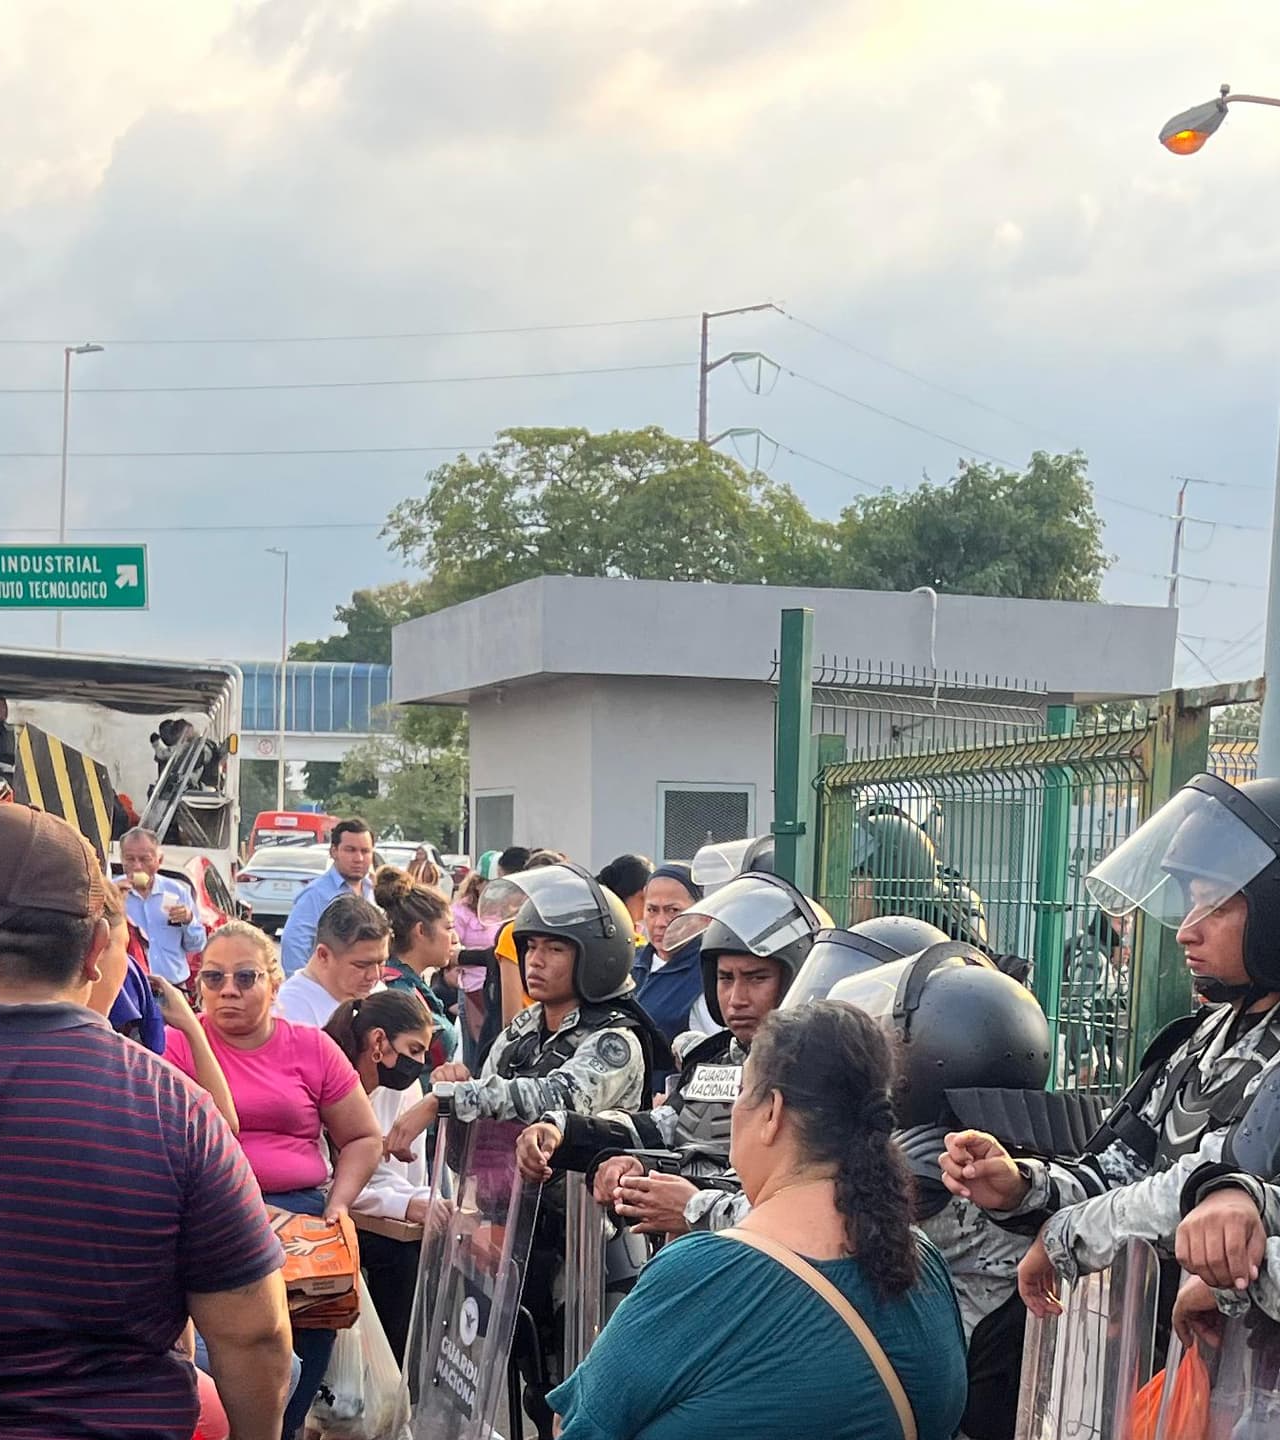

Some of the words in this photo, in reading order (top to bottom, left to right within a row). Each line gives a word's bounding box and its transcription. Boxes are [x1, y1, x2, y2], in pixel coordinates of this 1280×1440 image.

[1, 555, 102, 573] INDUSTRIAL
[28, 581, 108, 599] TECNOLOGICO
[697, 1068, 737, 1081] GUARDIA
[688, 1083, 736, 1097] NACIONAL
[436, 1356, 477, 1406] NACIONA
